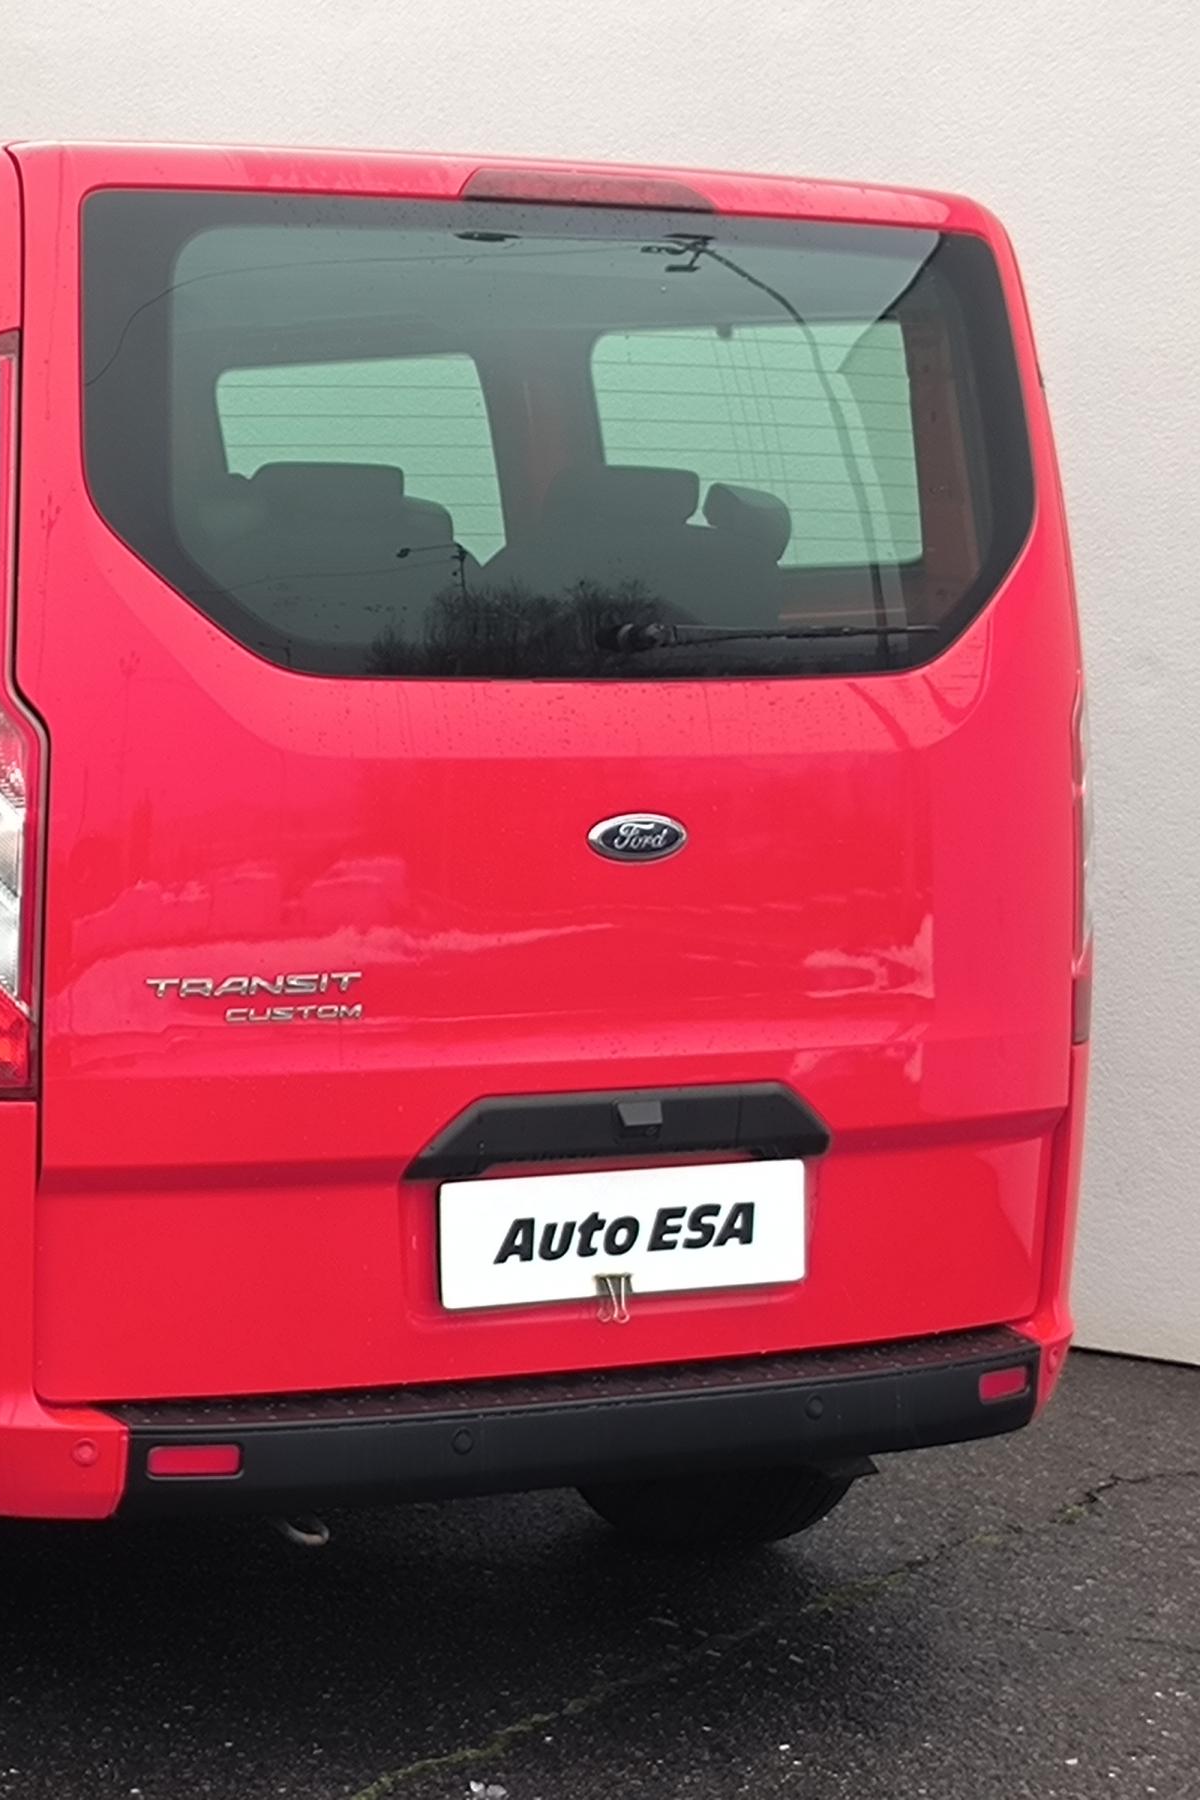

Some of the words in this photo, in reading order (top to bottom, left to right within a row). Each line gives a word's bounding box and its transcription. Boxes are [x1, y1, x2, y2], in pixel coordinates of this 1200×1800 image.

[614, 823, 668, 849] Ford
[146, 972, 362, 997] TRANSIT
[225, 1004, 362, 1022] CUSTOM
[493, 1211, 640, 1264] Auto
[646, 1202, 755, 1252] ESA
